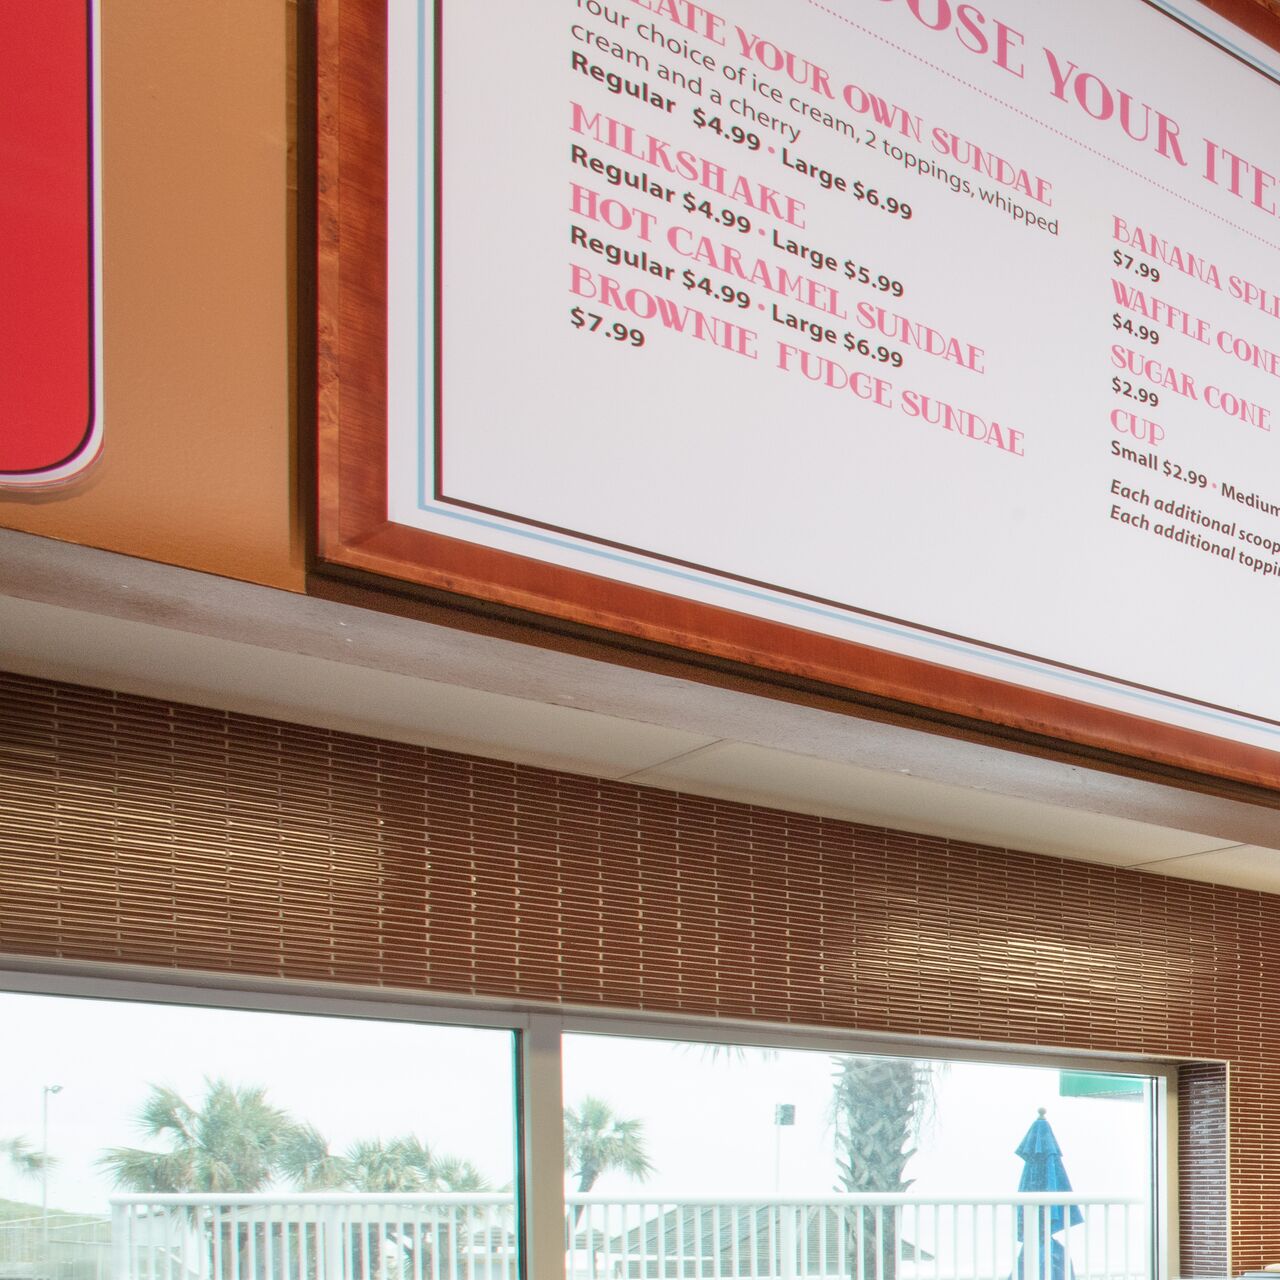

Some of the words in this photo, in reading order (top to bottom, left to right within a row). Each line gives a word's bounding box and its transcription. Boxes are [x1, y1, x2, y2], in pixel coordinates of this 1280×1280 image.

[566, 13, 650, 73] cream
[657, 64, 704, 98] and
[710, 89, 723, 108] a
[729, 98, 802, 145] cherry
[732, 19, 836, 100] YOUR
[842, 84, 924, 144] OWN
[931, 127, 1053, 208] SUNDAE
[1042, 47, 1189, 167] YOUR
[570, 101, 807, 231] MILKSHAKE
[571, 50, 677, 115] Regular
[693, 107, 762, 153] $4.99
[782, 147, 848, 194] Large
[853, 180, 914, 222] $6.99
[634, 13, 716, 72] choice
[721, 65, 748, 86] of
[751, 73, 784, 105] ice
[789, 97, 860, 144] cream,
[864, 128, 877, 150] 2
[882, 138, 975, 199] toppings,
[978, 187, 1059, 237] whipped
[571, 144, 677, 205] Regular
[683, 192, 753, 235] $4.99
[772, 229, 839, 273] Large
[844, 259, 905, 299] $5.99
[1112, 215, 1224, 292] BANANA
[1113, 248, 1162, 284] $7.99
[569, 182, 658, 244] HOT
[667, 226, 848, 321] CARAMEL
[856, 302, 985, 375] SUNDAE
[571, 225, 677, 282] Regular
[683, 269, 752, 311] $4.99
[772, 303, 839, 346] Large
[844, 331, 905, 369] $6.99
[1111, 278, 1211, 347] WAFFLE
[569, 263, 758, 361] BROWNIE
[777, 341, 893, 410] FUDGE
[901, 390, 1025, 458] SUNDAE
[571, 306, 646, 349] $7.99
[1112, 312, 1161, 346] $4.99
[1110, 409, 1166, 448] CUP
[1111, 344, 1199, 402] SUGAR
[1204, 385, 1272, 433] CONE
[1112, 376, 1160, 409] $2.99
[1109, 478, 1151, 507] Each
[1153, 498, 1237, 538] additional
[1111, 440, 1159, 472] Small
[1163, 459, 1209, 490] $2.99
[1110, 504, 1151, 532] Each
[1153, 524, 1237, 562] additional
